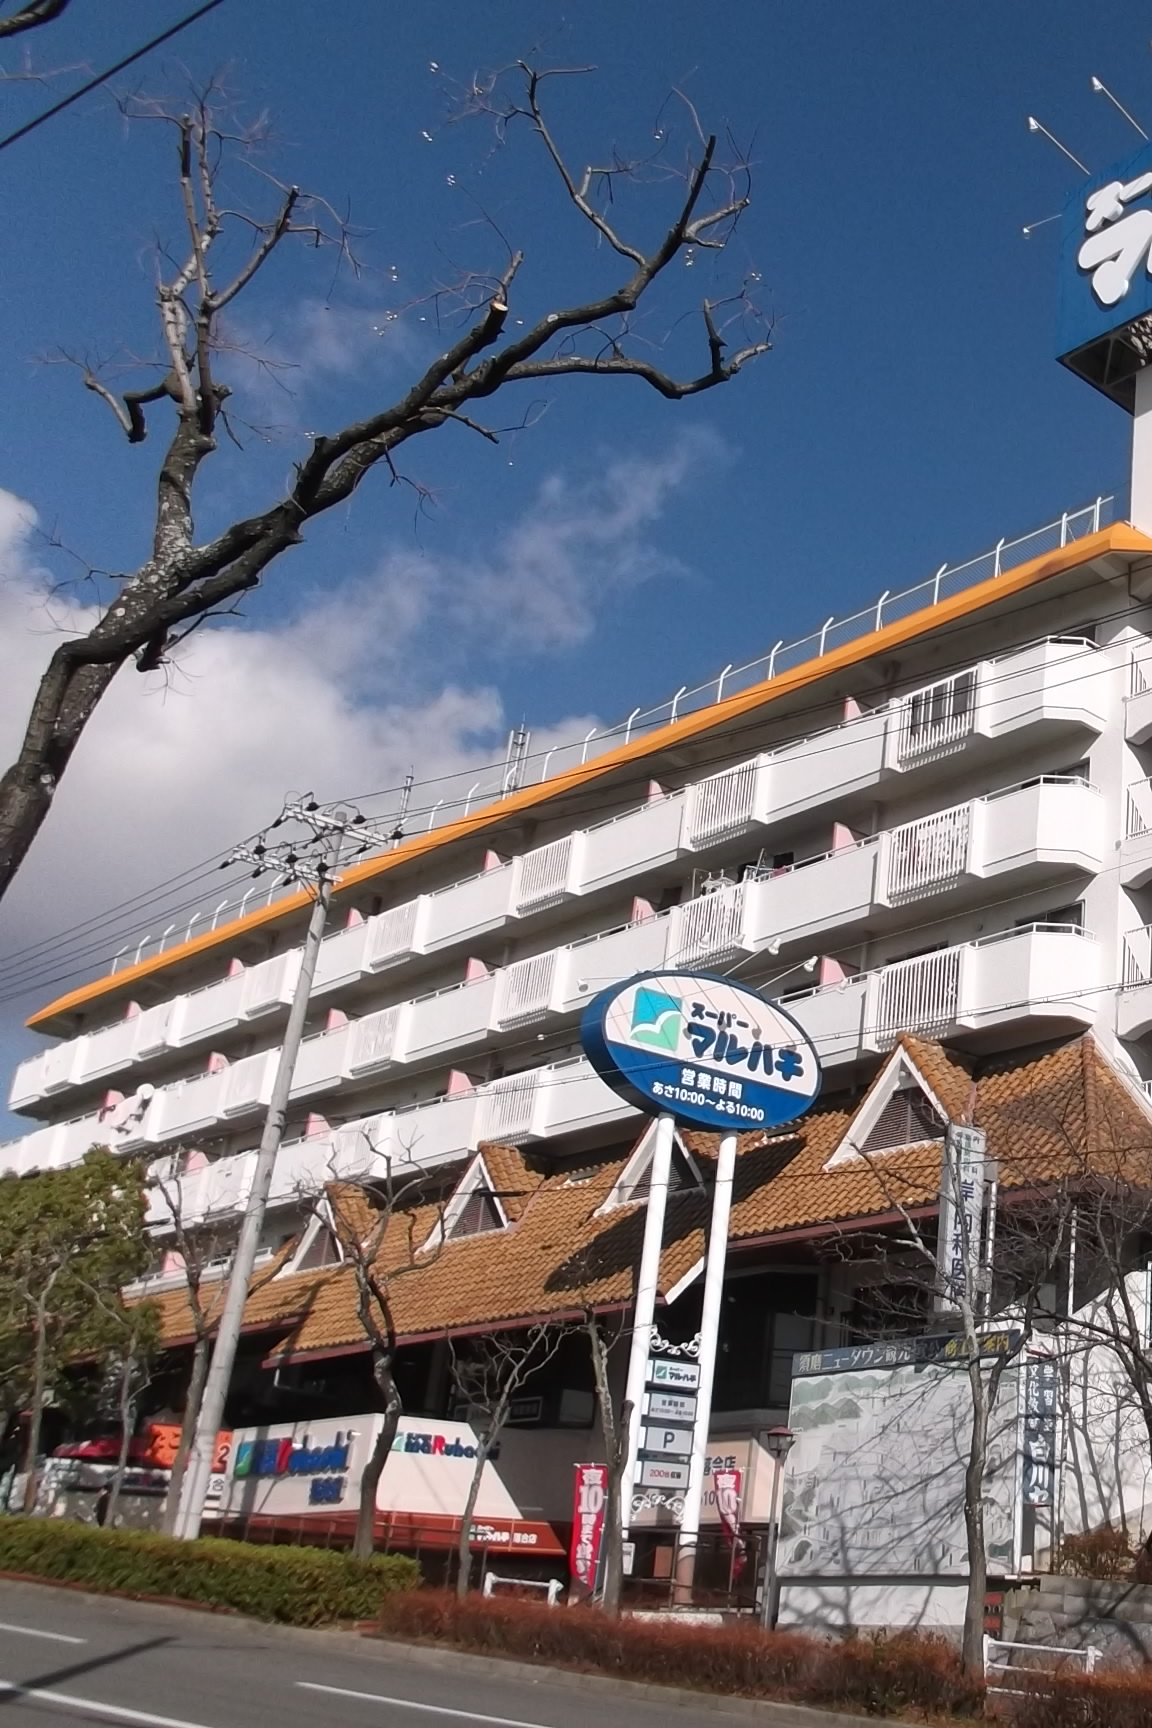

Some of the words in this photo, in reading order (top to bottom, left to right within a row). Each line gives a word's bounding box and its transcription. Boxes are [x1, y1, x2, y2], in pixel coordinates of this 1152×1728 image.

[692, 1001, 750, 1029] スーパー
[687, 1021, 805, 1082] マルハチ
[680, 1068, 743, 1100] 営業時間
[663, 1431, 675, 1448] P
